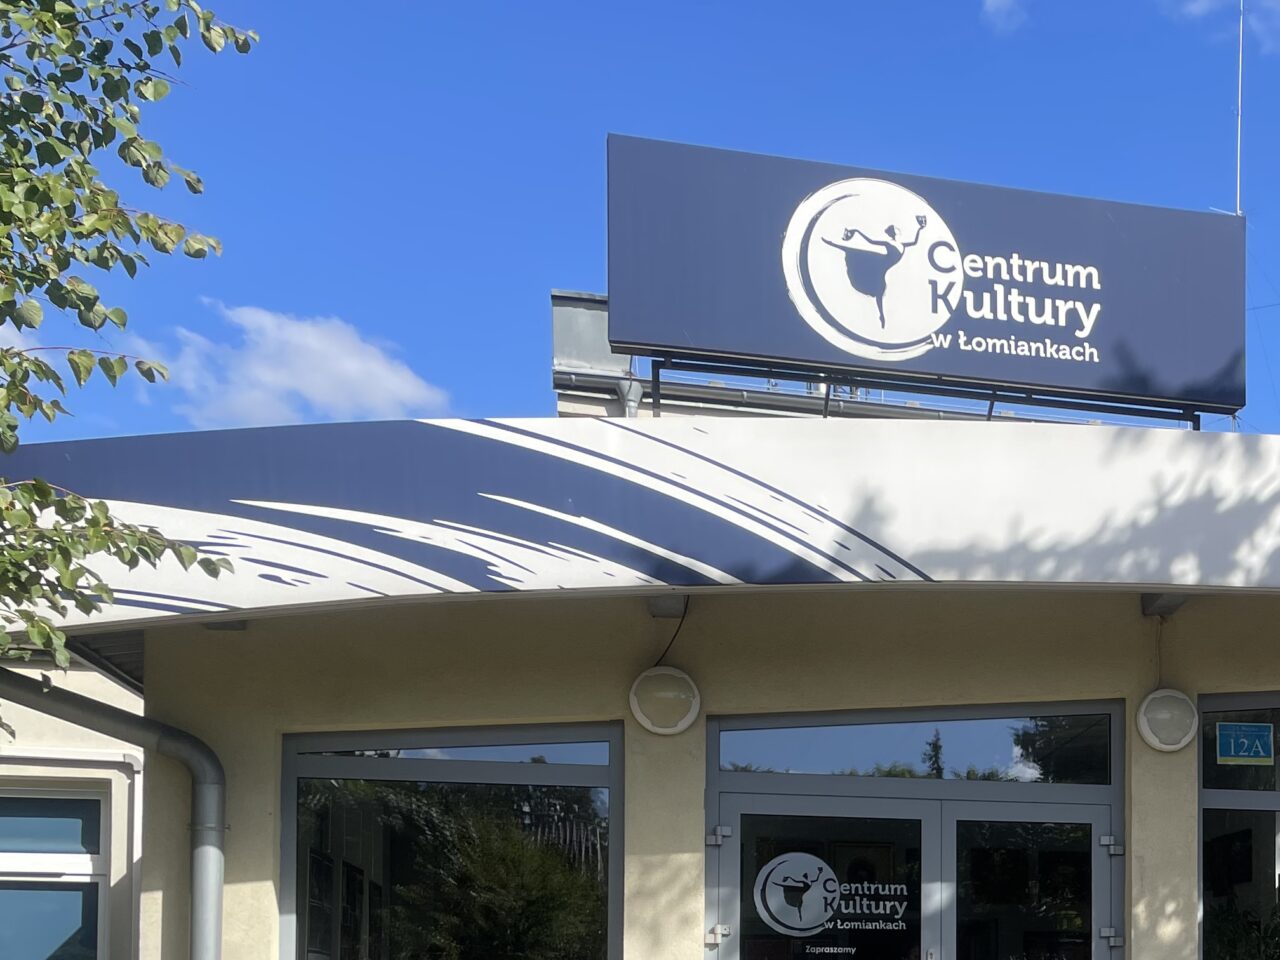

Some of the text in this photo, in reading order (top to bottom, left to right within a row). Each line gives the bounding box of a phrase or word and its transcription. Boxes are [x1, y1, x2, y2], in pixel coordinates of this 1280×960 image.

[928, 240, 1101, 290] Centrum
[928, 279, 1101, 337] Kultury
[931, 330, 1100, 363] w Łomiankach
[1229, 738, 1266, 756] 12A
[823, 878, 908, 895] Centrum
[823, 896, 908, 919] Kultury
[824, 919, 907, 930] w Łomiankach
[805, 945, 857, 955] Zapraszamy
